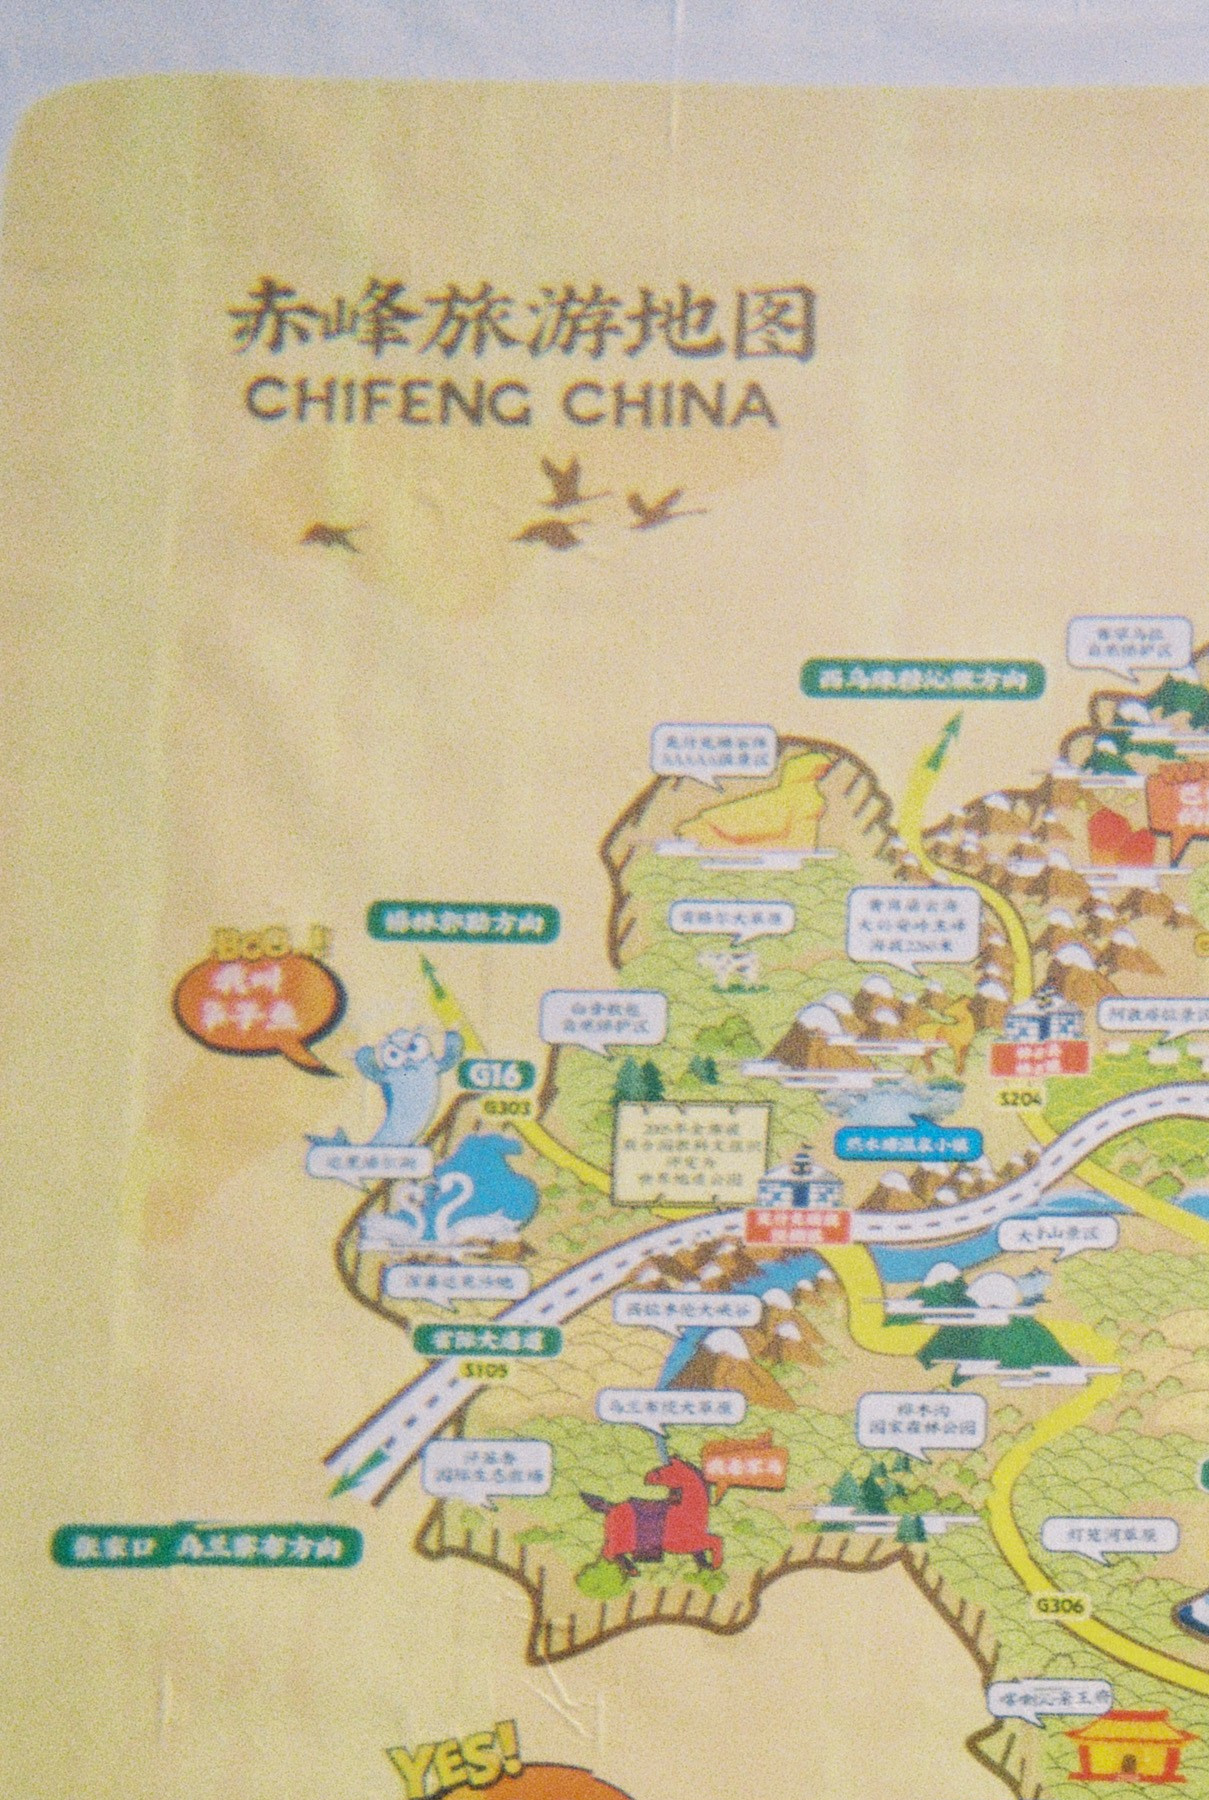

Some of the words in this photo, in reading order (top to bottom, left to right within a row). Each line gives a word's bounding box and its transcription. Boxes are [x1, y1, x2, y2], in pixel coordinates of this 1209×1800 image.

[226, 275, 818, 363] 赤峰旅游地图
[244, 375, 532, 427] CHIFENG
[561, 379, 780, 429] CHINA
[469, 1061, 523, 1089] G16
[1036, 1597, 1086, 1615] G306
